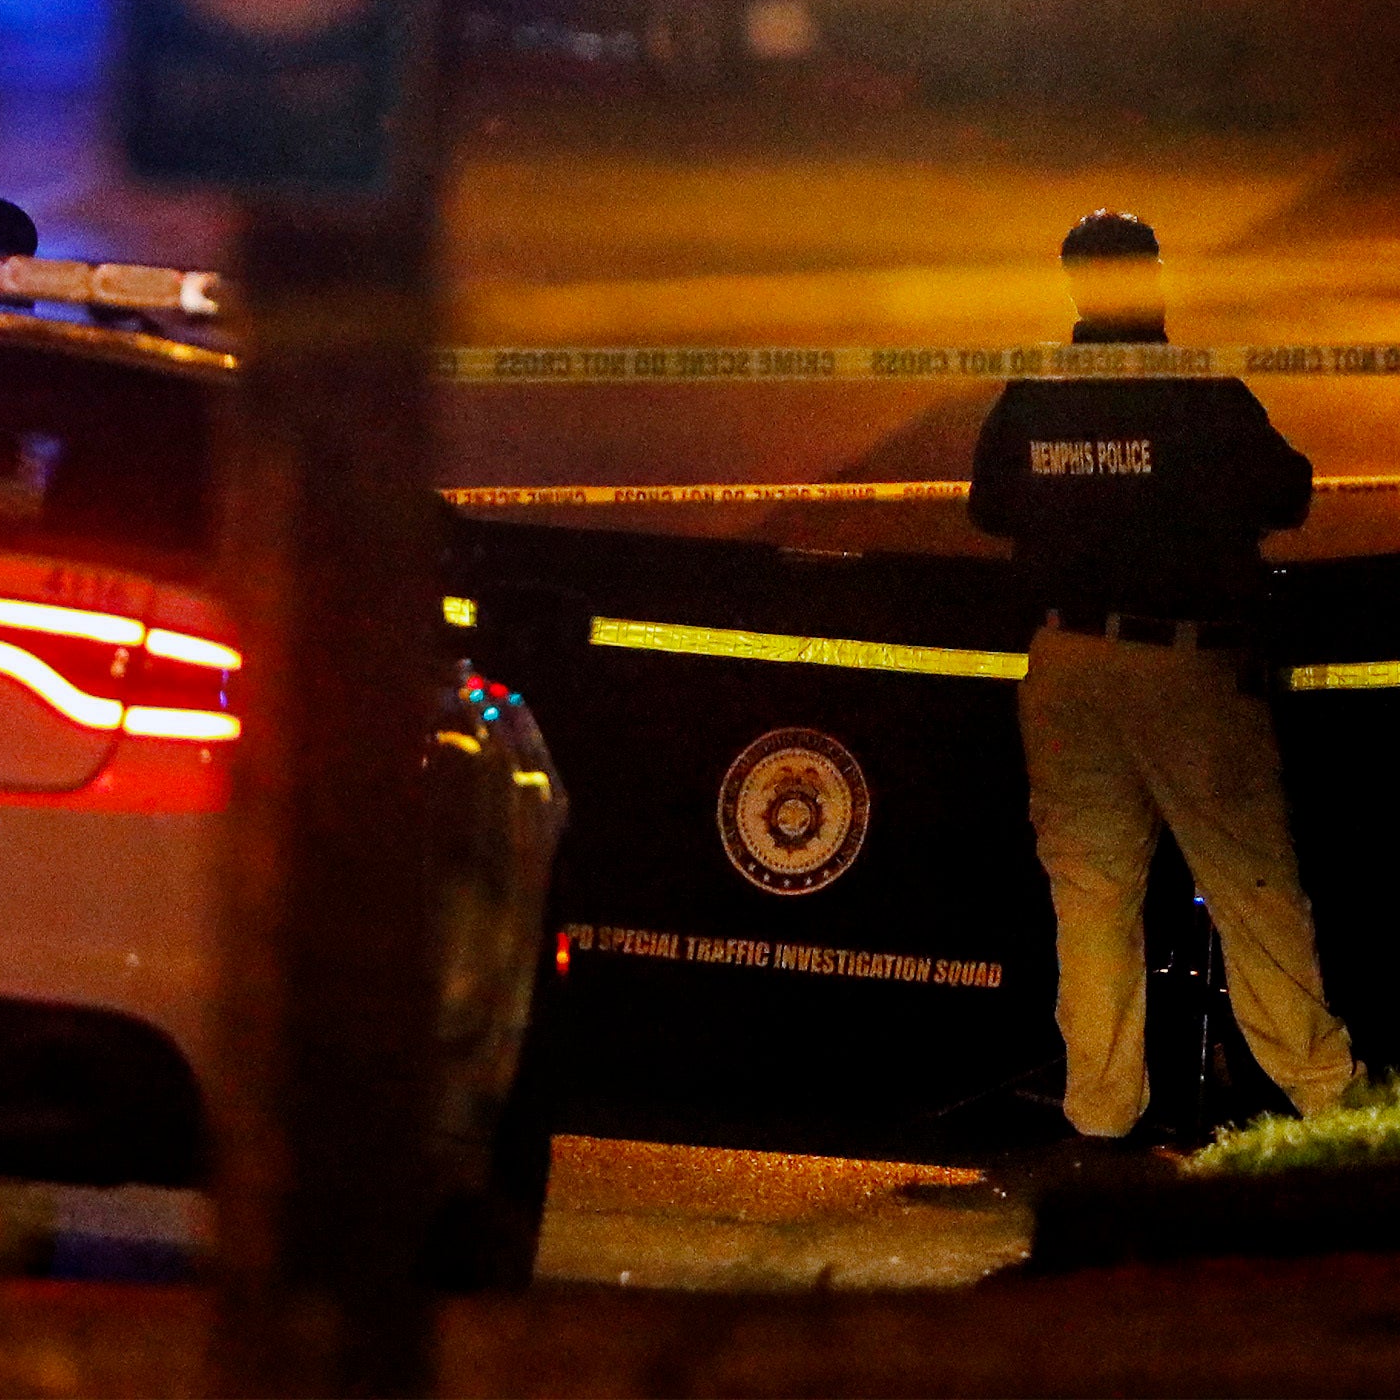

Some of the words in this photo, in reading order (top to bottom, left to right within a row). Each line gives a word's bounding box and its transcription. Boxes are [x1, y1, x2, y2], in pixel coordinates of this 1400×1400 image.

[1030, 440, 1095, 475] MEMPHIS
[1097, 439, 1152, 474] POLICE
[598, 925, 680, 959] SPECIAL
[685, 936, 771, 967] TRAFFIC
[773, 943, 933, 983] INVESTIGATION
[933, 959, 1002, 988] SQUAD
